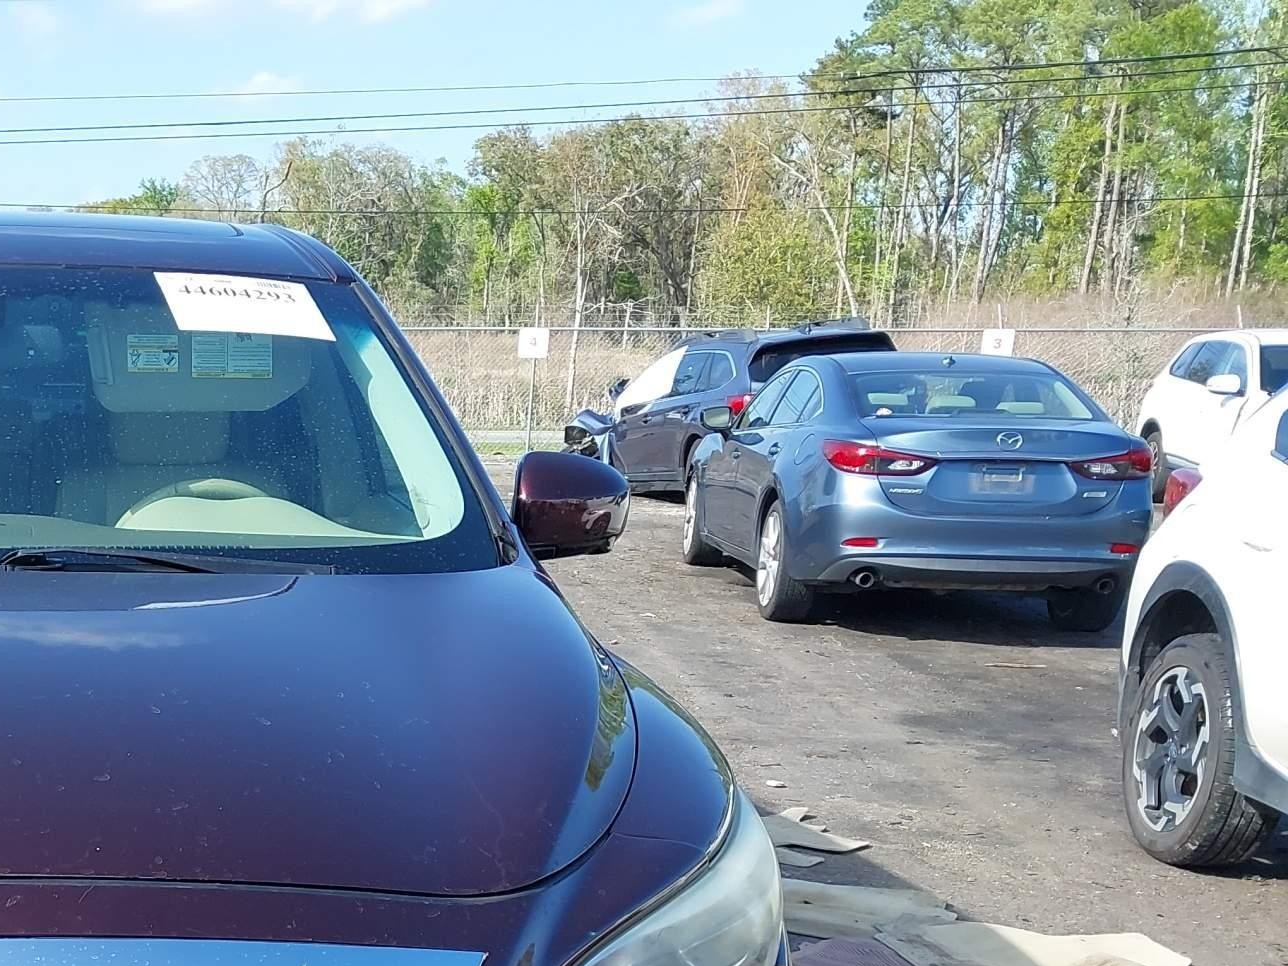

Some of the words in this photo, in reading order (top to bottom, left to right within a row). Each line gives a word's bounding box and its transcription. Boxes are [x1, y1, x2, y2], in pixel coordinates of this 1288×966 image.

[178, 284, 297, 304] 44604293
[528, 336, 537, 347] 4
[992, 337, 1003, 349] 3
